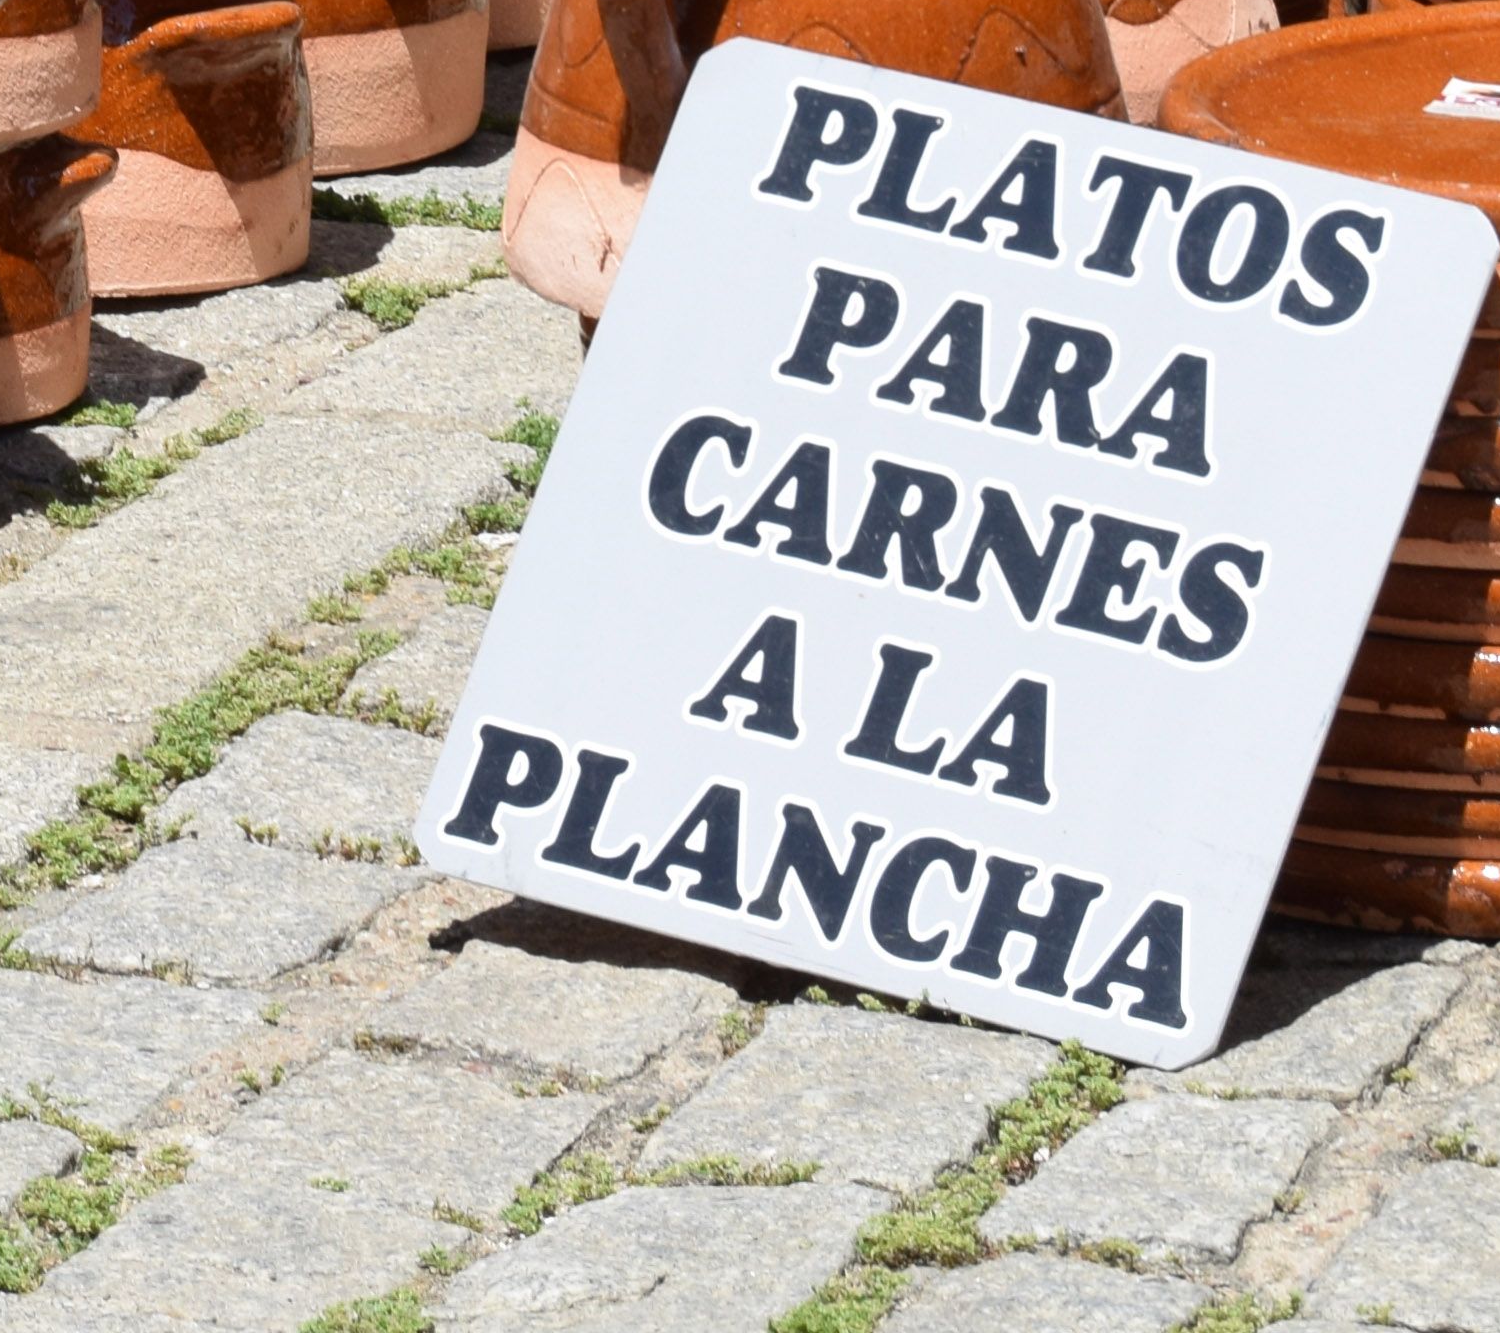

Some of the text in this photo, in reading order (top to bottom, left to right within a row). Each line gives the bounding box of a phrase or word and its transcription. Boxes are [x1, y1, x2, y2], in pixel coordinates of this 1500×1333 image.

[760, 88, 1383, 326] PLATOS
[780, 268, 1210, 477] PARA
[649, 417, 1264, 662] CARNES
[690, 617, 1050, 805] A LA
[446, 725, 1187, 1029] PLANCHA
